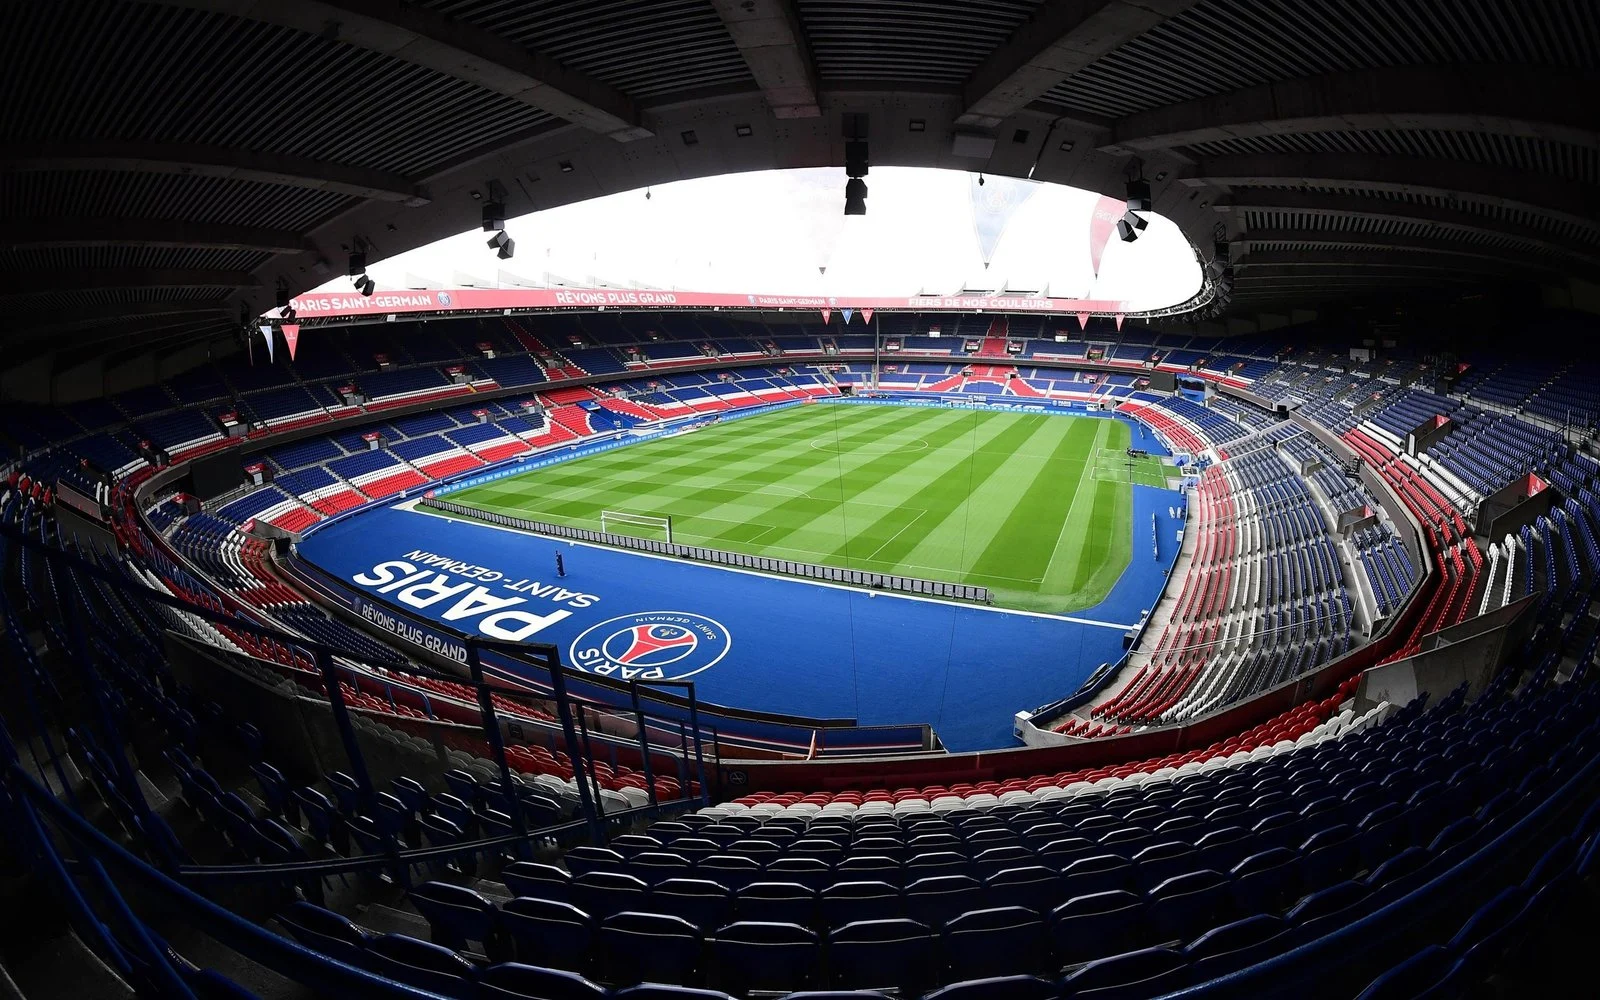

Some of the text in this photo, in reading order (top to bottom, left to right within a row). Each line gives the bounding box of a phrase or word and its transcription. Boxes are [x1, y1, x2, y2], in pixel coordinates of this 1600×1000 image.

[288, 295, 432, 312] PARIS SAINT-GERMAIN
[555, 290, 677, 304] RÊVONS PLUS GRAND
[758, 297, 826, 305] PARIS SAINT-GERMAIN
[908, 298, 1054, 309] FIERS DE NOS COULEURS
[352, 561, 573, 642] PARIS
[362, 603, 468, 663] RÊVONS PLUS GRAND
[577, 648, 665, 682] PARIS
